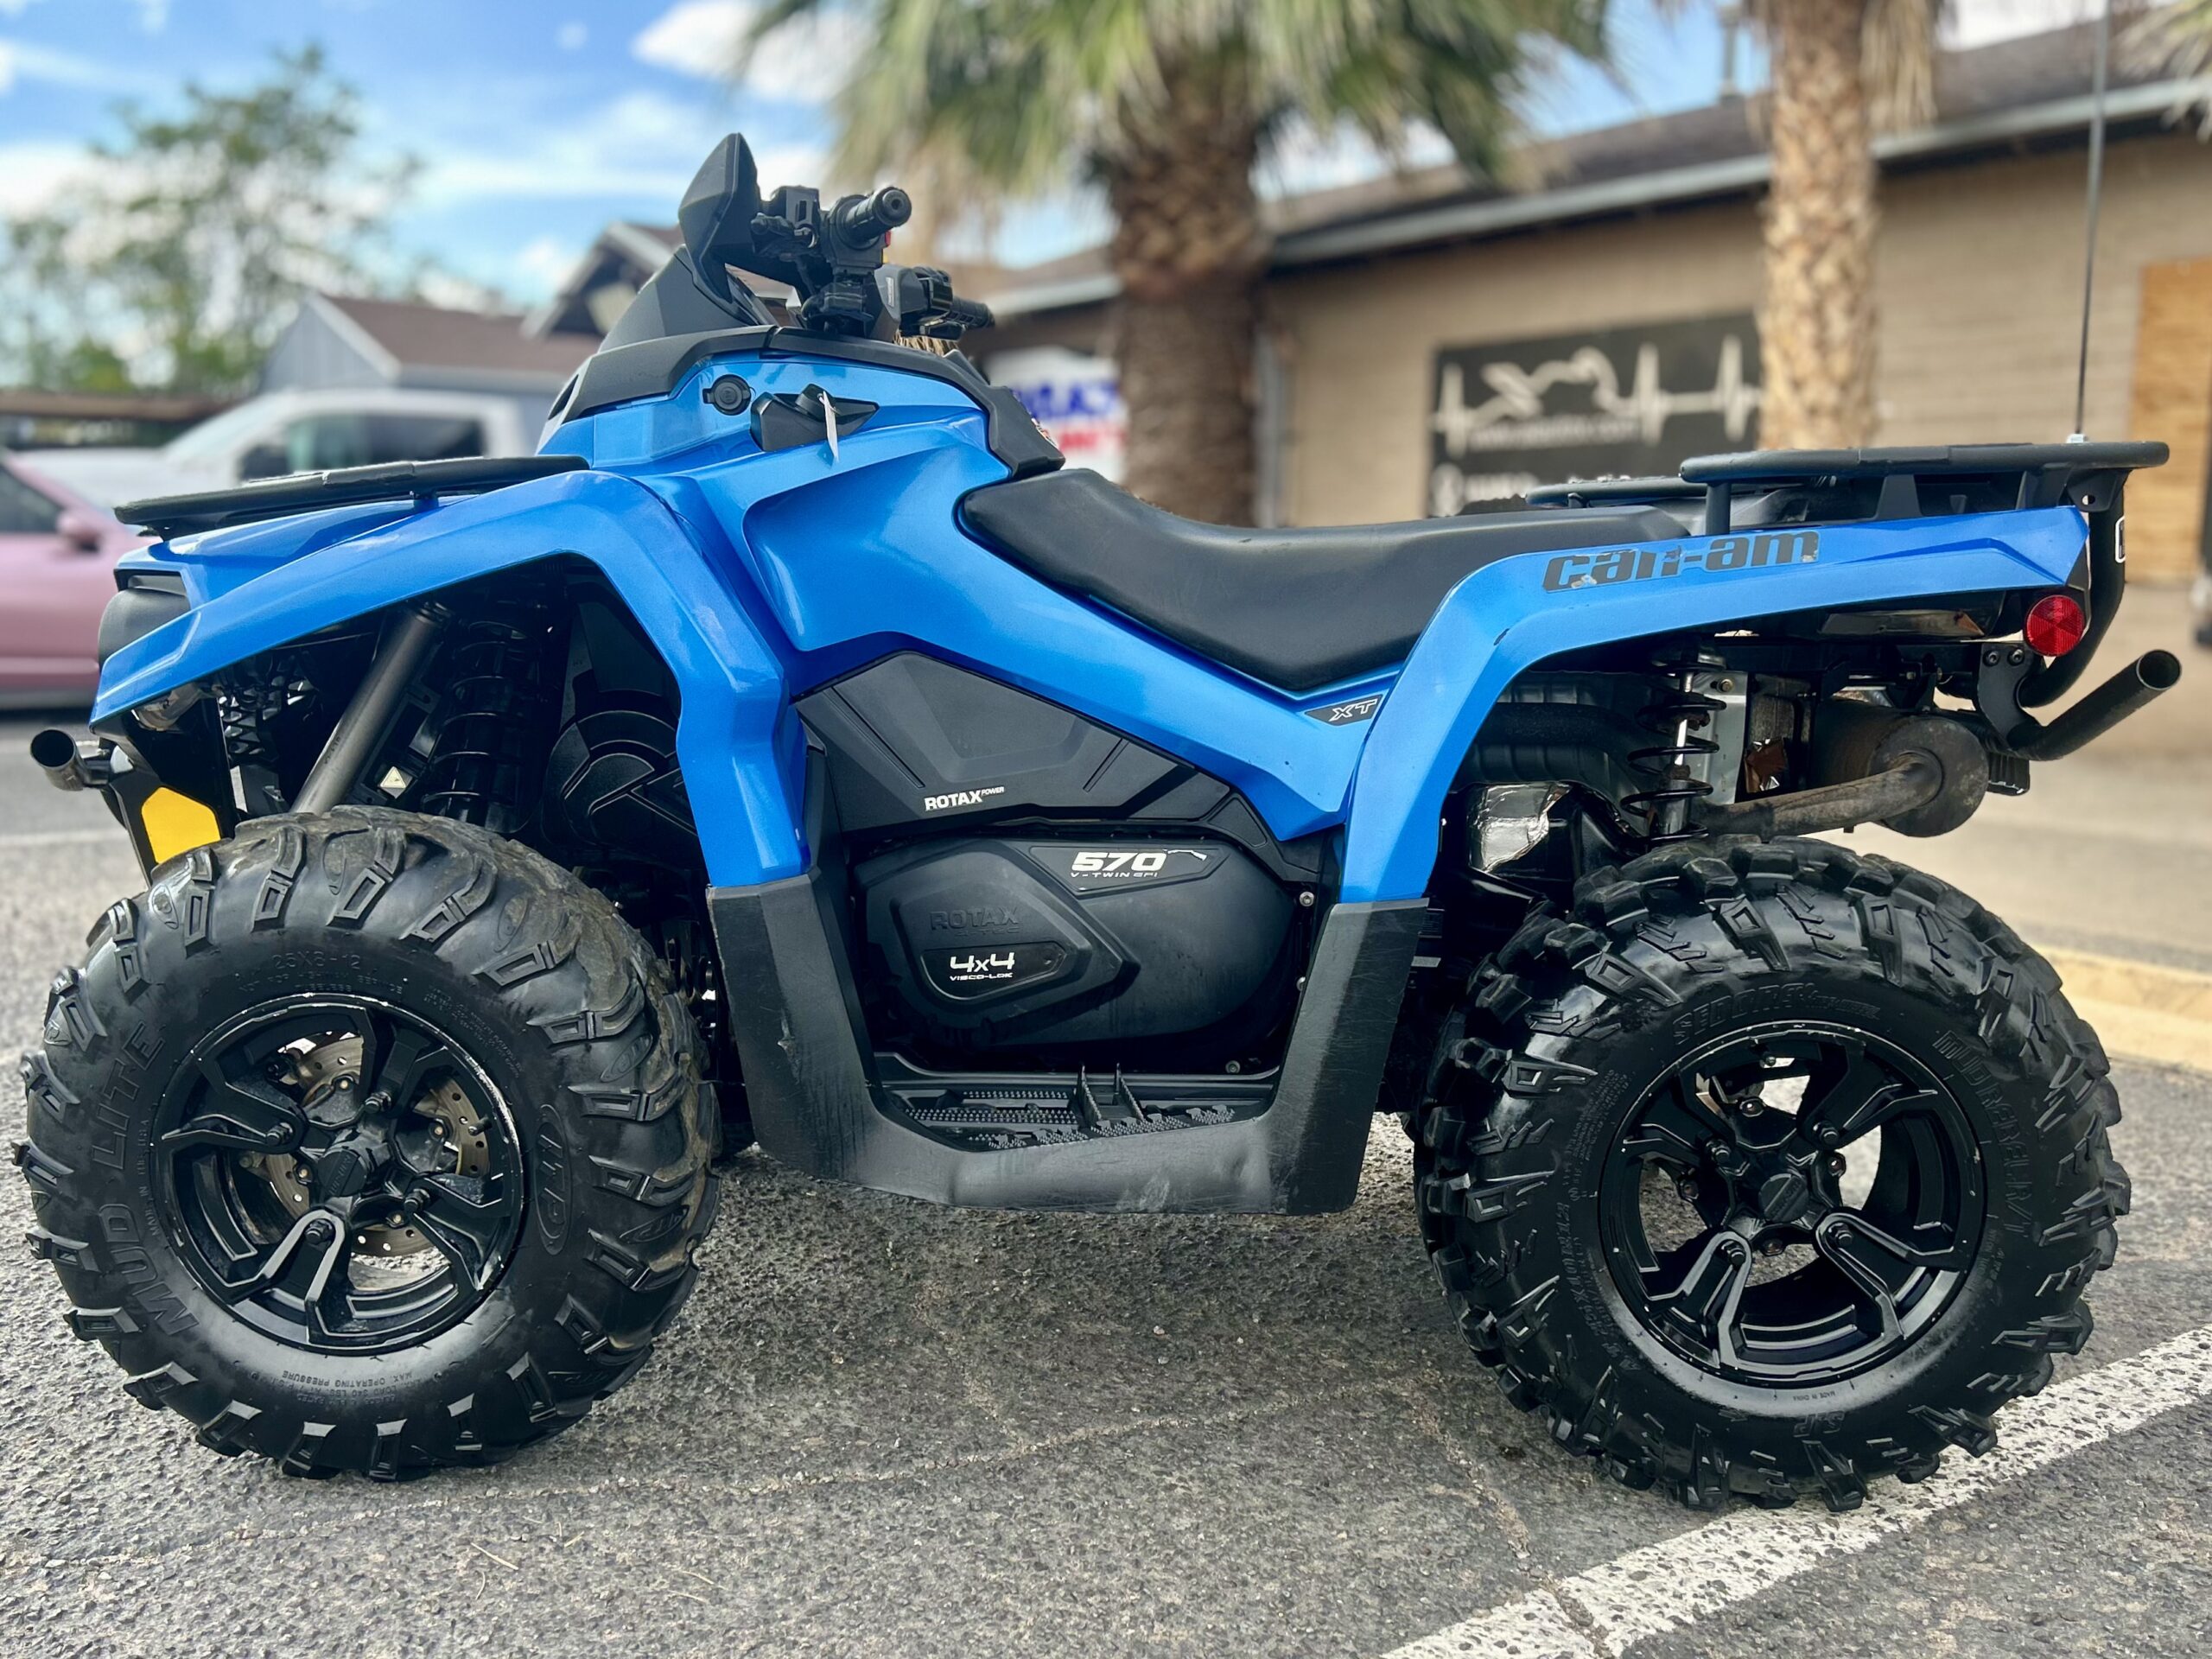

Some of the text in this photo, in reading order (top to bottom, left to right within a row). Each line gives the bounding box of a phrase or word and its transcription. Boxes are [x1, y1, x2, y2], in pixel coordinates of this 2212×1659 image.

[1541, 531, 1820, 593] can-am
[1329, 698, 1378, 721] XT
[924, 785, 1005, 811] ROTAX POWER
[1071, 851, 1167, 872] 570
[929, 907, 1020, 931] ROTAX
[950, 952, 1015, 973] 4x4
[950, 973, 1014, 982] VISCO-LOK
[92, 1020, 200, 1336] MUD LITE
[282, 1370, 331, 1387] PRESSURE
[334, 1377, 387, 1389] OPERATING
